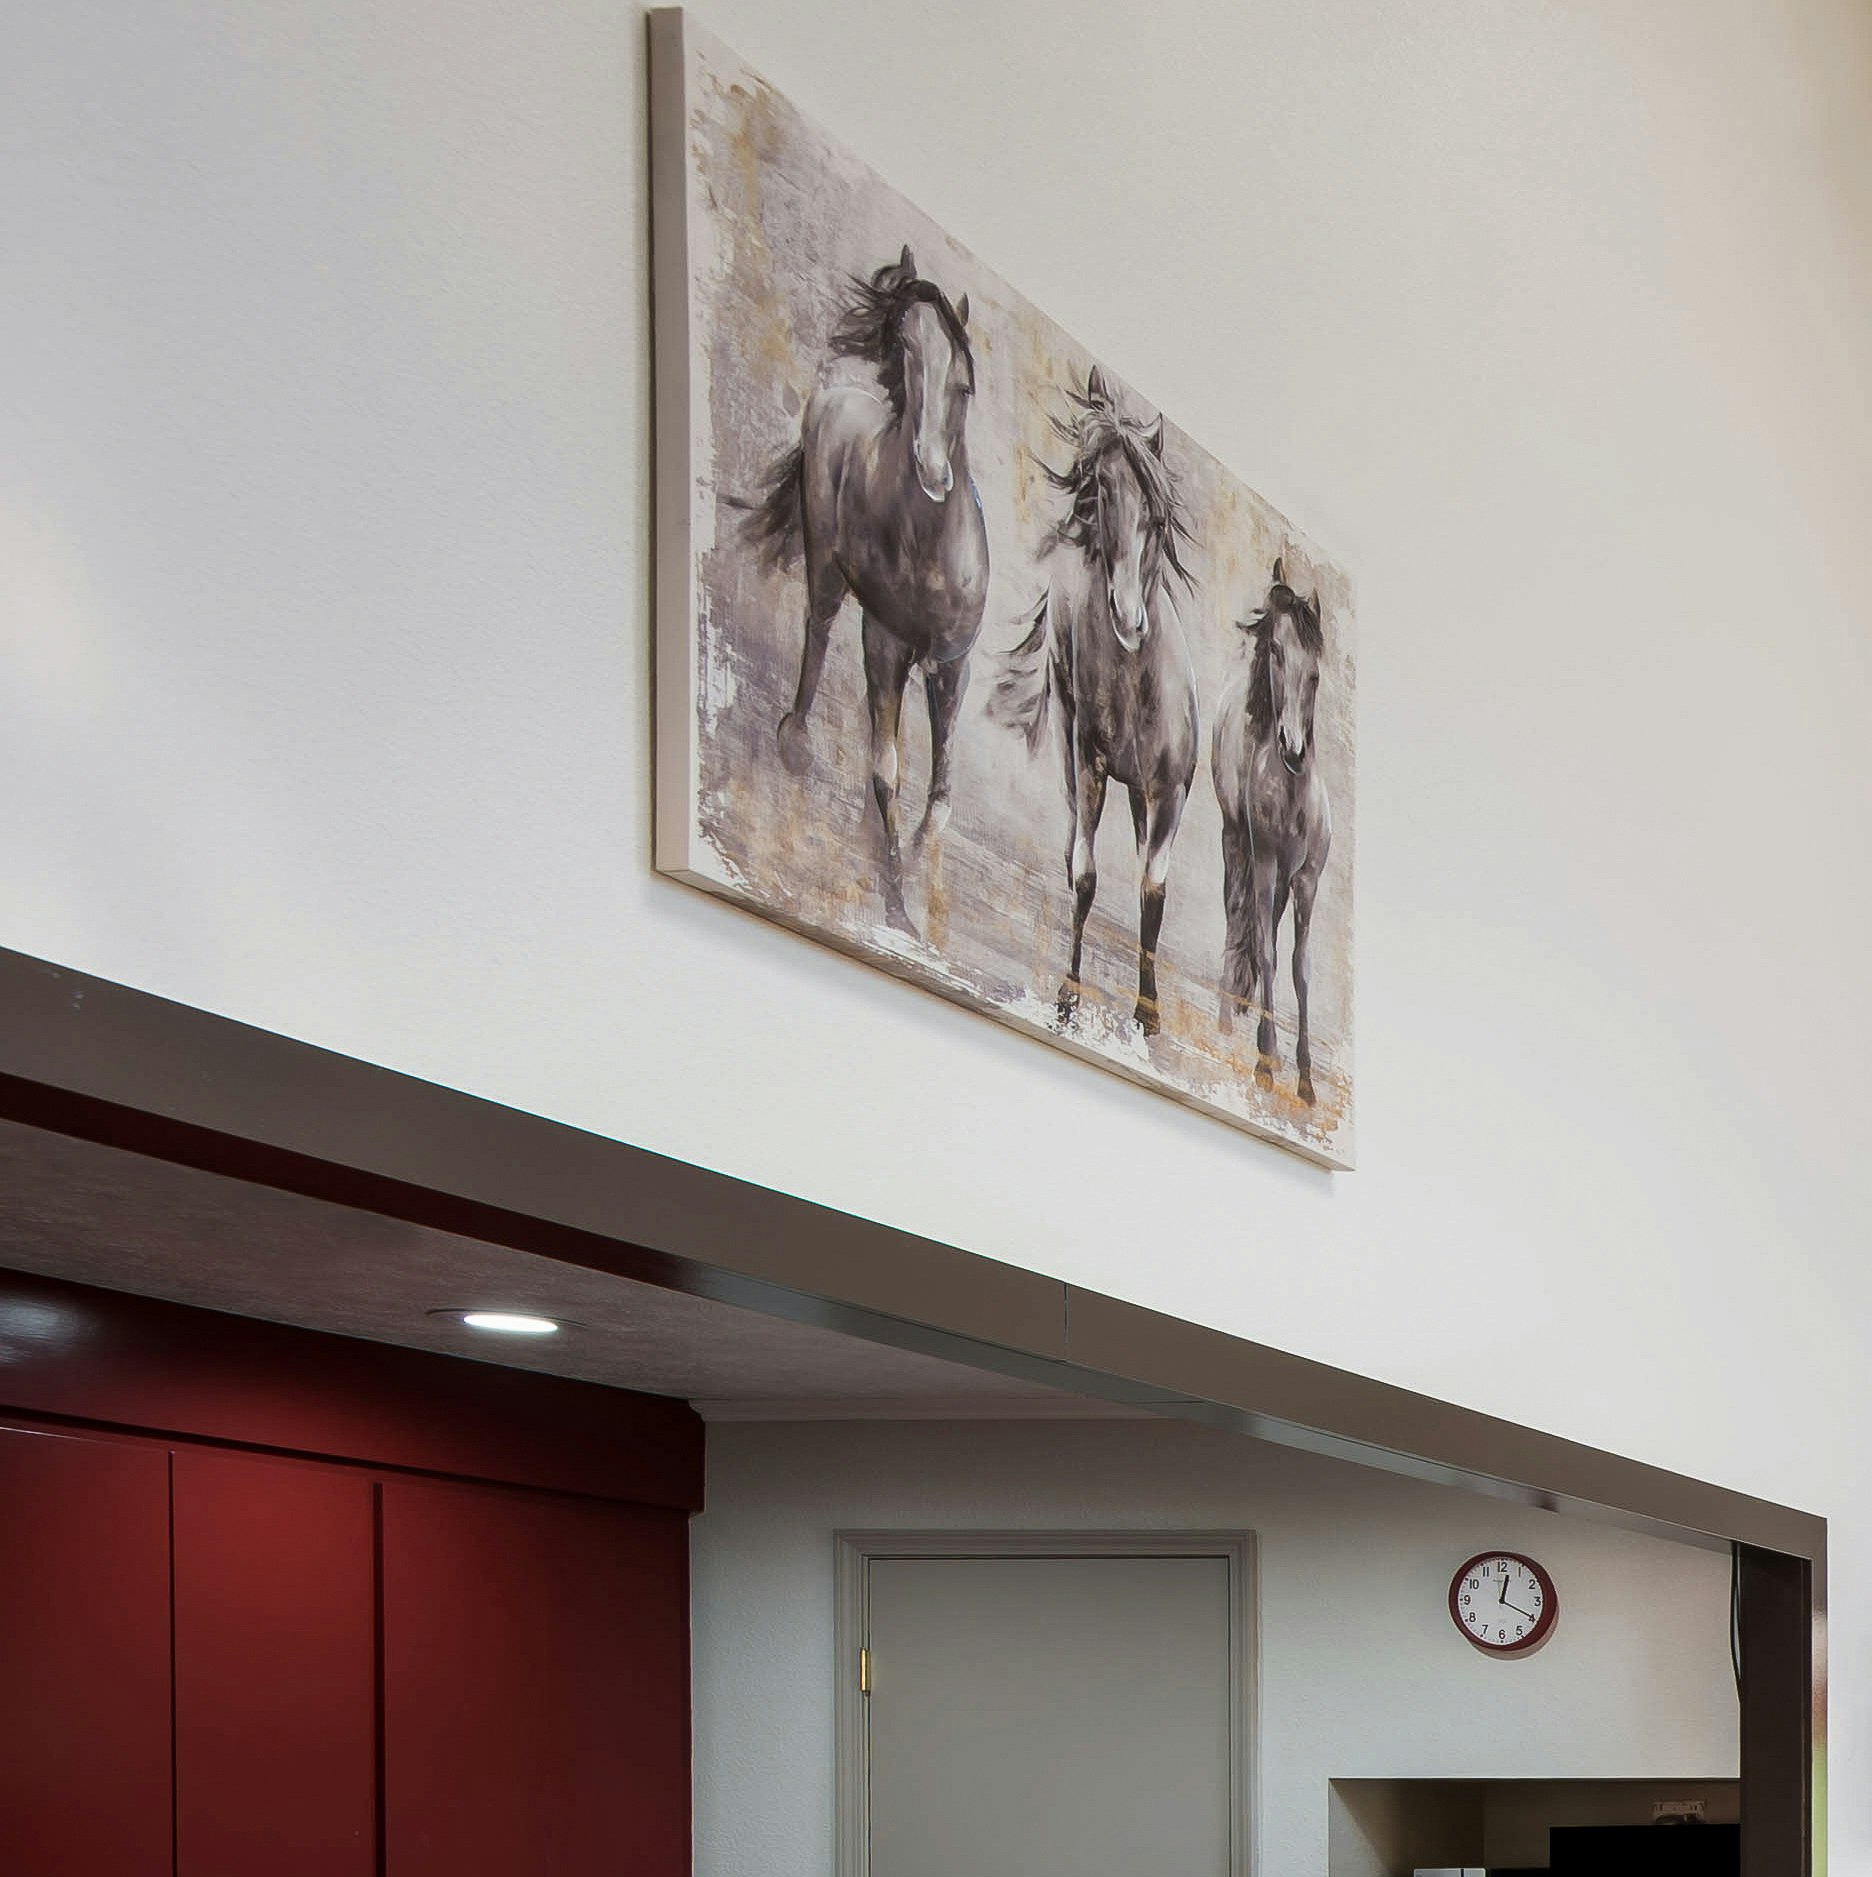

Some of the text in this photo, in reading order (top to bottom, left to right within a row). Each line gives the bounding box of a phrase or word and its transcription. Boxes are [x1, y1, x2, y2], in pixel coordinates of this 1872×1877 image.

[1482, 1567, 1490, 1577] 11
[1497, 1562, 1508, 1573] 12
[1469, 1579, 1480, 1590] 10
[1528, 1579, 1536, 1590] 2
[1464, 1595, 1471, 1606] 9
[1534, 1596, 1542, 1607] 3
[1469, 1612, 1477, 1623] 8
[1481, 1624, 1489, 1635] 7
[1498, 1629, 1506, 1640] 6
[1516, 1625, 1523, 1636] 5
